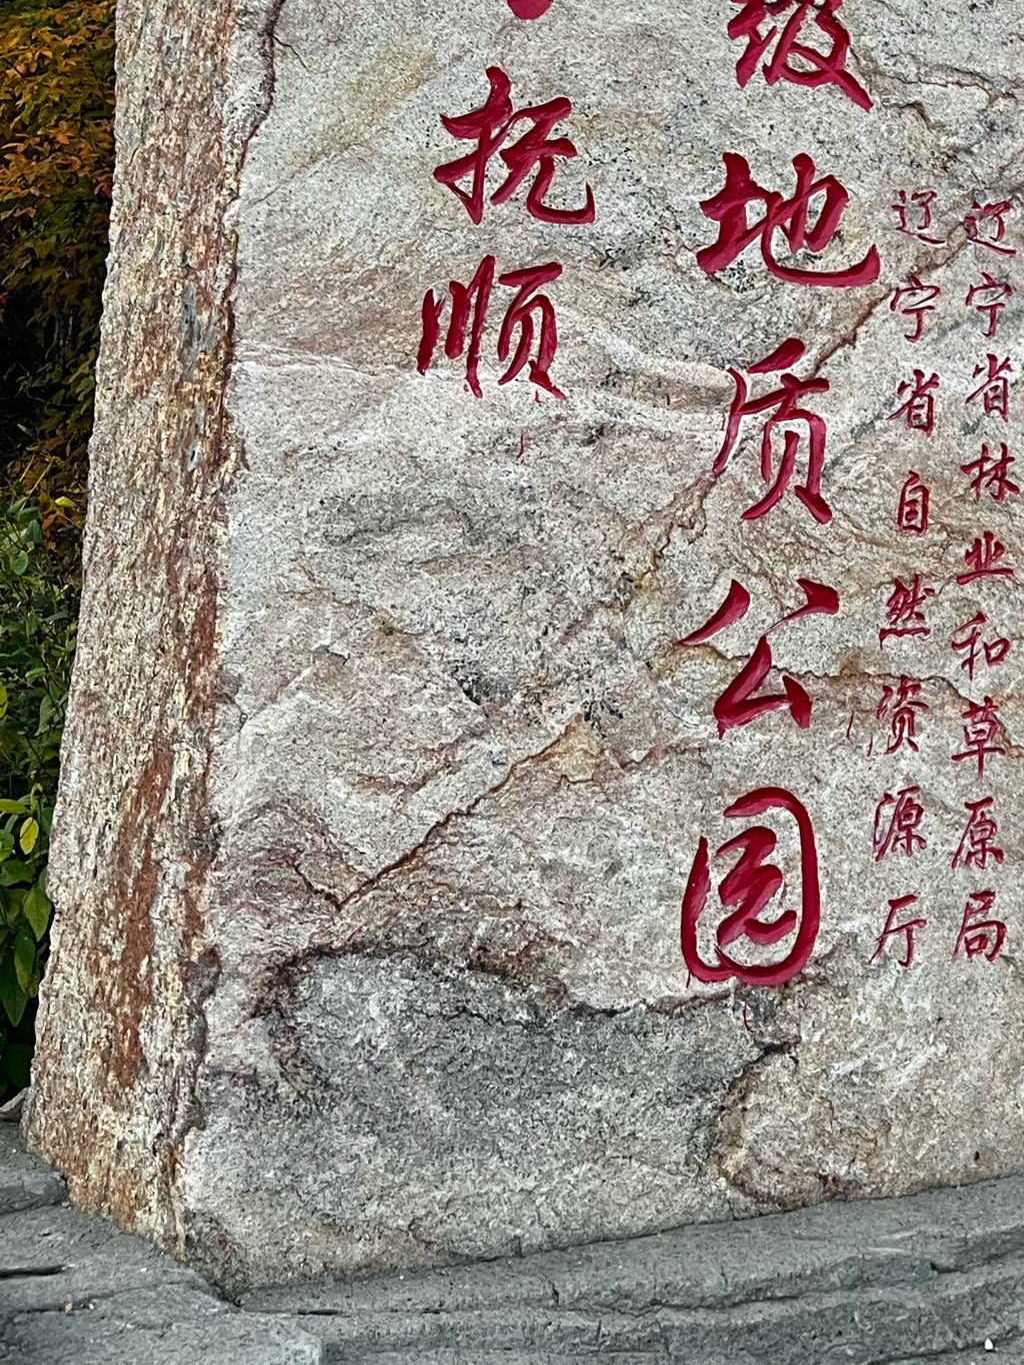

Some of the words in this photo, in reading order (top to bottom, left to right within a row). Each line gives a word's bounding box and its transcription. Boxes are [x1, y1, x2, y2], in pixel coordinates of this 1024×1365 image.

[869, 190, 946, 968] 辽宁省自然资源厅
[952, 200, 1019, 963] 辽宁省林业和草原局
